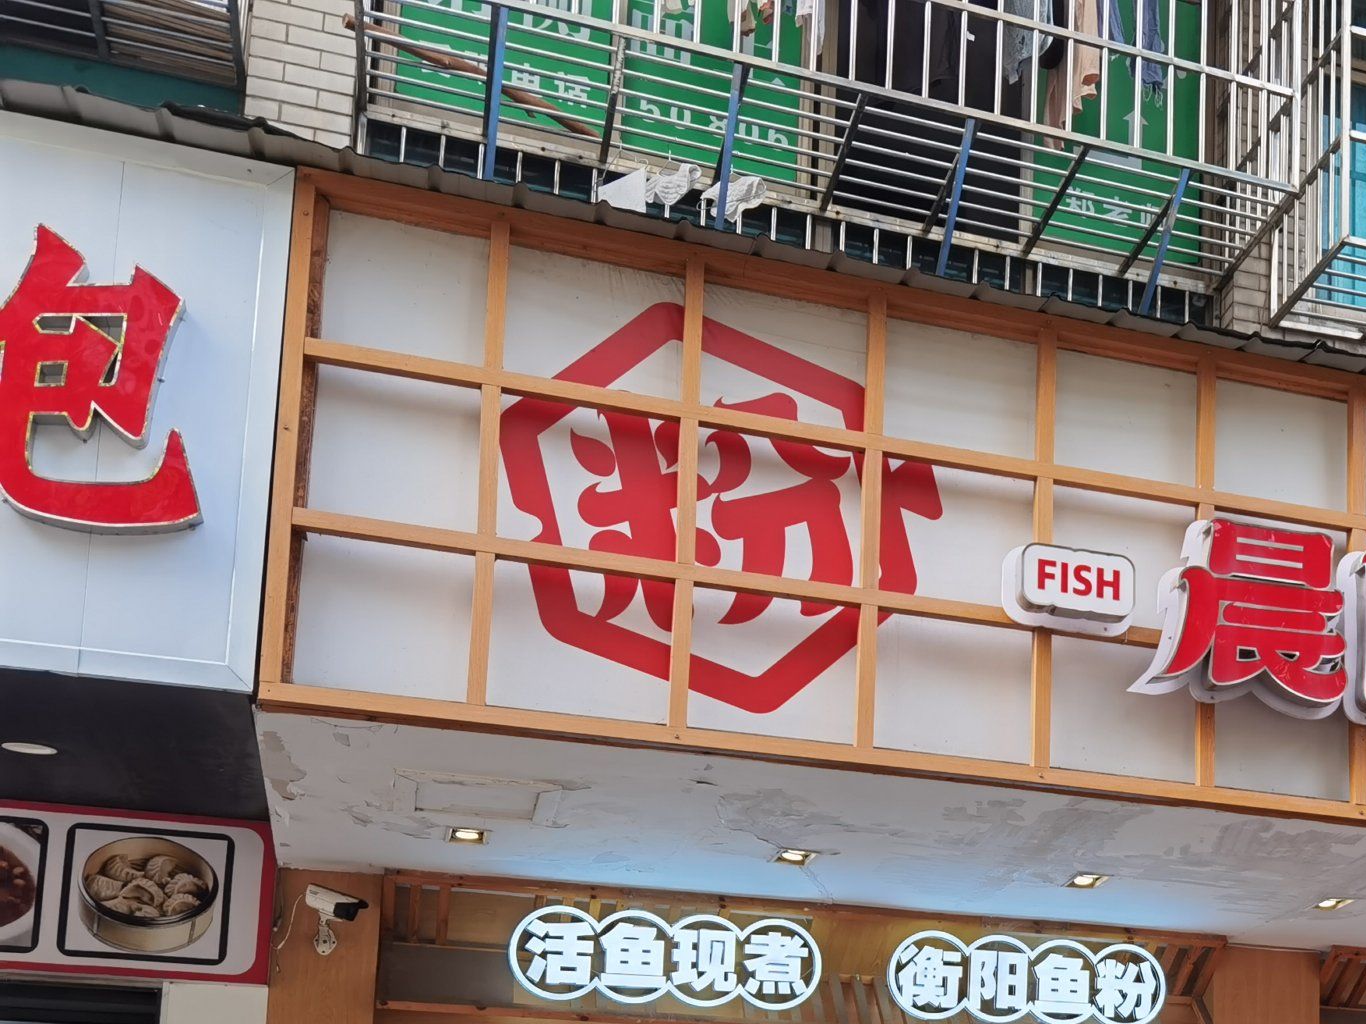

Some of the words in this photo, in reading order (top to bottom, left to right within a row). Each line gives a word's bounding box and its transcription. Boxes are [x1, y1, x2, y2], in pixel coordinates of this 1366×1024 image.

[0, 224, 203, 537] 包
[1037, 558, 1121, 601] FISH
[524, 919, 810, 997] 活鱼现煮
[898, 944, 1155, 1022] 衡阳鱼粉
